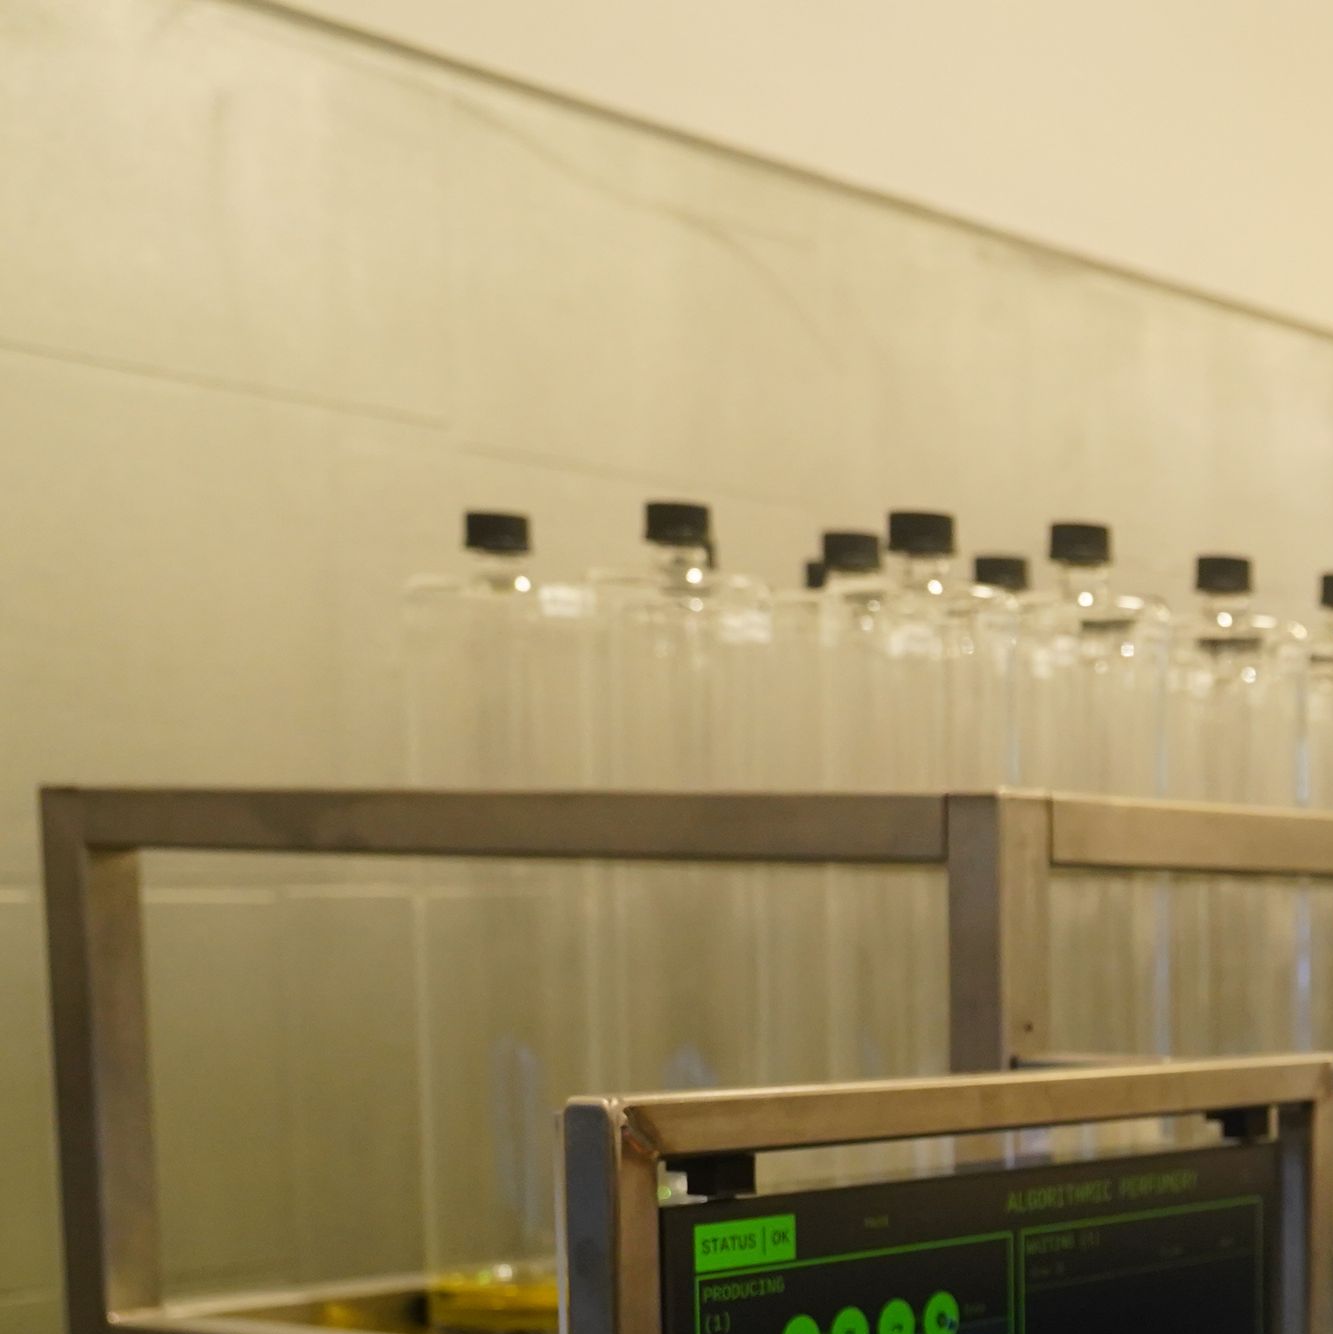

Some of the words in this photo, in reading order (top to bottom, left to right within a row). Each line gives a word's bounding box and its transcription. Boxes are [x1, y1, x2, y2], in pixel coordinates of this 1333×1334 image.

[1008, 1179, 1112, 1212] ALGORITHMIC
[702, 1234, 757, 1253] STATUS
[773, 1231, 789, 1246] OK
[703, 1275, 785, 1303] PRODUCING
